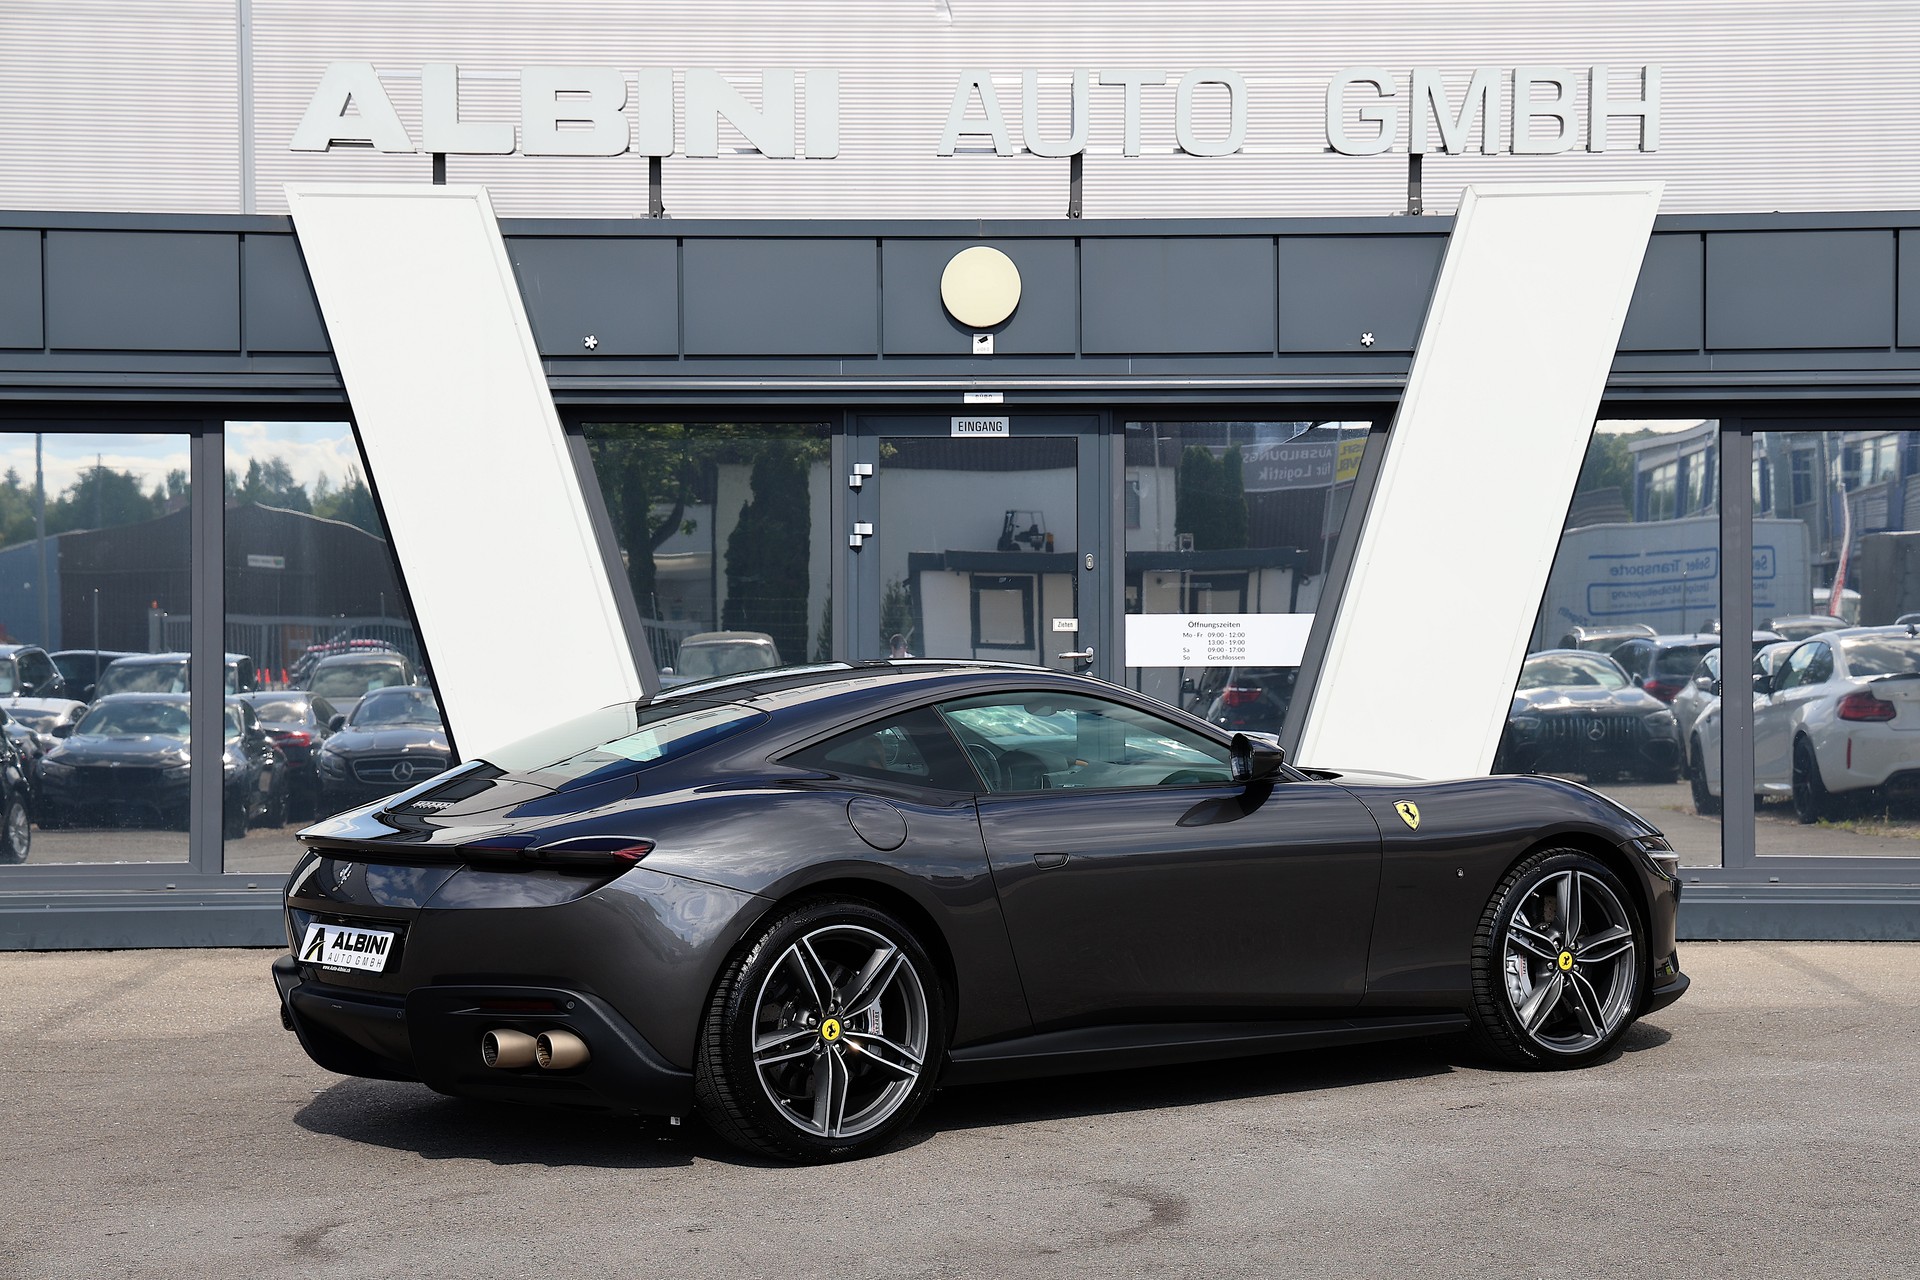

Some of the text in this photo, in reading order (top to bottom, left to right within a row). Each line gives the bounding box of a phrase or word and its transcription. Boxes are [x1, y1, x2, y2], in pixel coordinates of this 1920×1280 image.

[289, 61, 1662, 160] ALBINI AUTO GMBH
[958, 421, 1003, 432] EINGANG
[1187, 620, 1241, 629] Öffnungszeiten
[331, 931, 389, 955] ALBINI
[327, 952, 383, 968] AUTO GMBH
